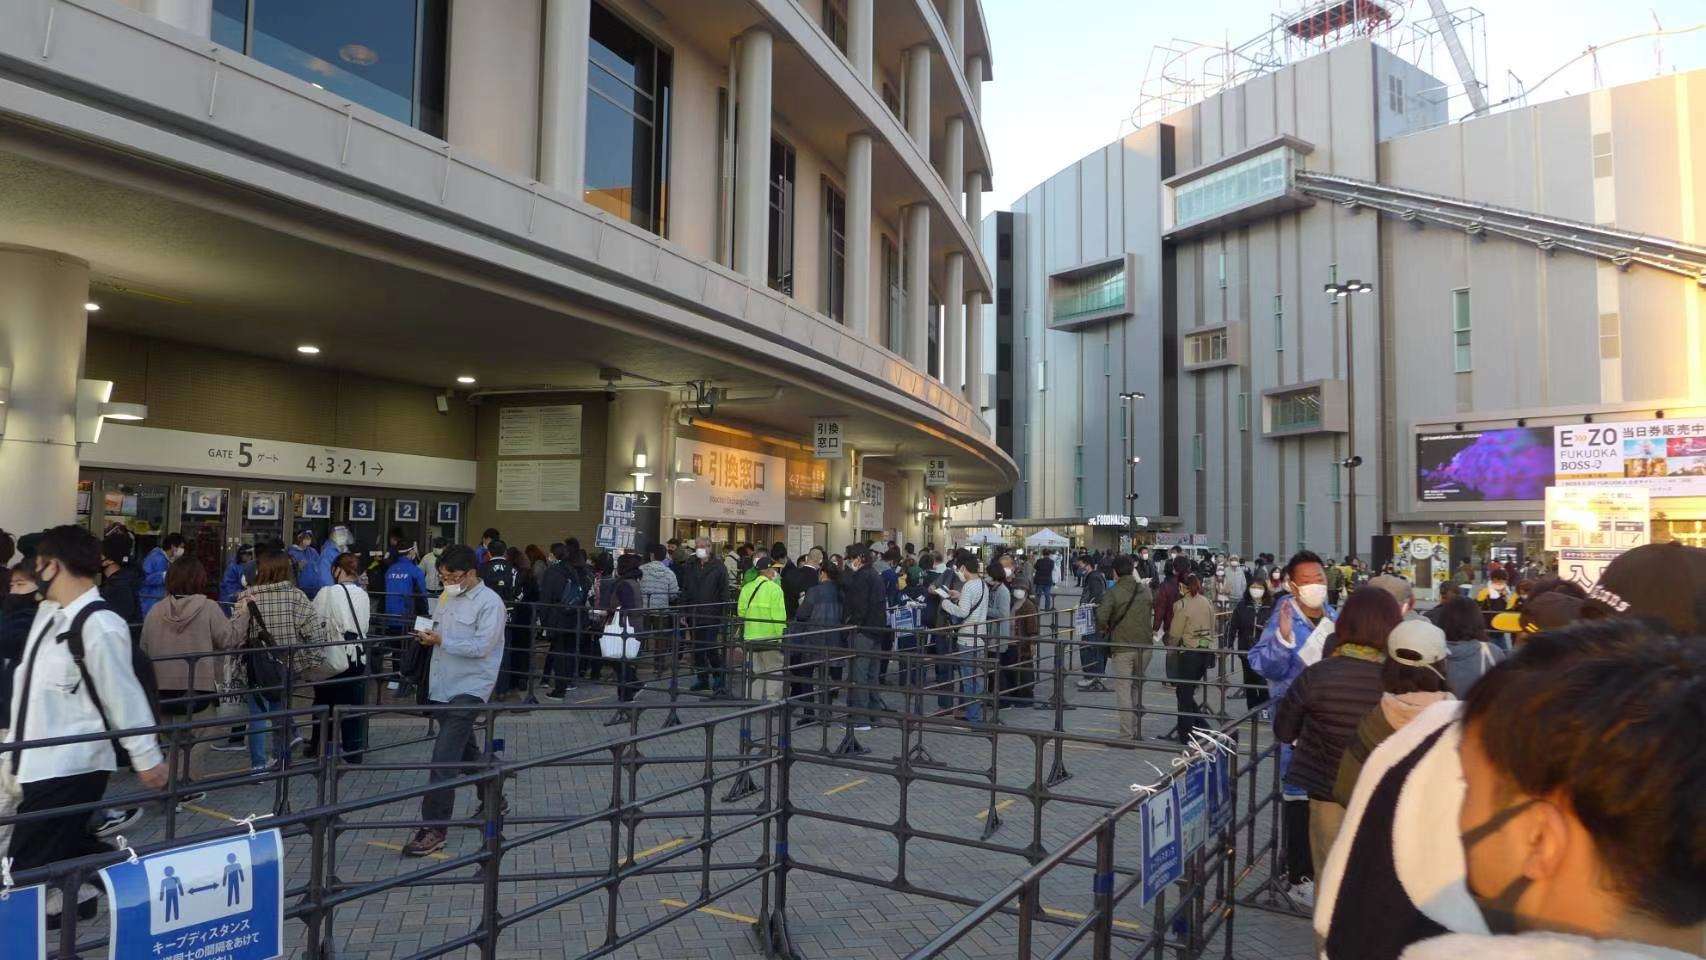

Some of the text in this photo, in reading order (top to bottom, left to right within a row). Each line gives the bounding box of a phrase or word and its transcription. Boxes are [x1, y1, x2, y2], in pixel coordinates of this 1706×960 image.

[817, 422, 839, 435] 引換
[1622, 424, 1705, 438] 当日券販売中
[817, 437, 839, 448] 窓口
[208, 448, 233, 459] GATE
[238, 442, 253, 468] 5
[257, 453, 279, 463] ゲート
[1560, 448, 1618, 459] FUKUOKA
[709, 451, 765, 491] 引換窓口
[199, 494, 211, 509] 6
[258, 498, 269, 514] 5
[312, 500, 322, 514] 4
[358, 502, 367, 516] 3
[403, 505, 412, 518] 2
[445, 507, 452, 519] 1
[152, 918, 251, 955] キープディスタンス
